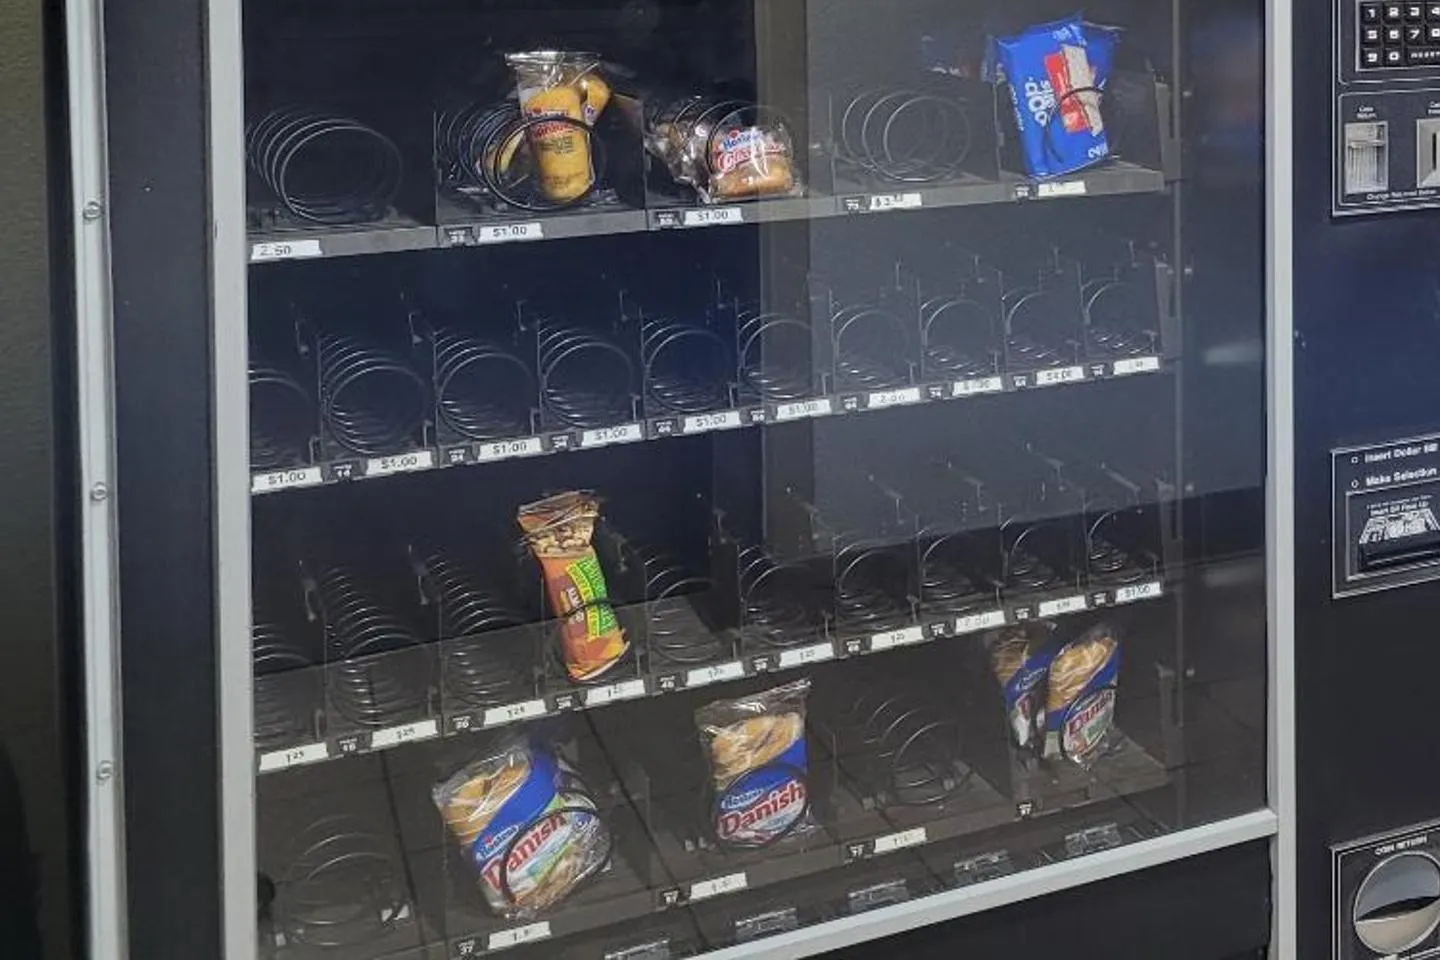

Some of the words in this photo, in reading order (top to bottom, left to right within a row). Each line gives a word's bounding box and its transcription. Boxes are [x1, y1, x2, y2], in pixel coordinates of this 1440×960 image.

[1368, 9, 1376, 18] 1
[1389, 7, 1399, 17] 2
[1410, 7, 1420, 17] 3
[1431, 7, 1440, 16] 4
[1367, 30, 1378, 39] 5
[1389, 30, 1399, 39] 6
[1410, 29, 1420, 38] 7
[1367, 53, 1378, 62] 9
[698, 210, 729, 220] $1.00
[492, 226, 527, 238] $1.00
[696, 414, 727, 427] $1.00
[594, 427, 627, 440] $1.00
[492, 441, 528, 454] $1.00
[380, 455, 418, 469] $1.00
[268, 471, 306, 485] $1.00
[1365, 474, 1391, 486] Make
[1393, 467, 1438, 482] Selection
[717, 780, 806, 840] Danish
